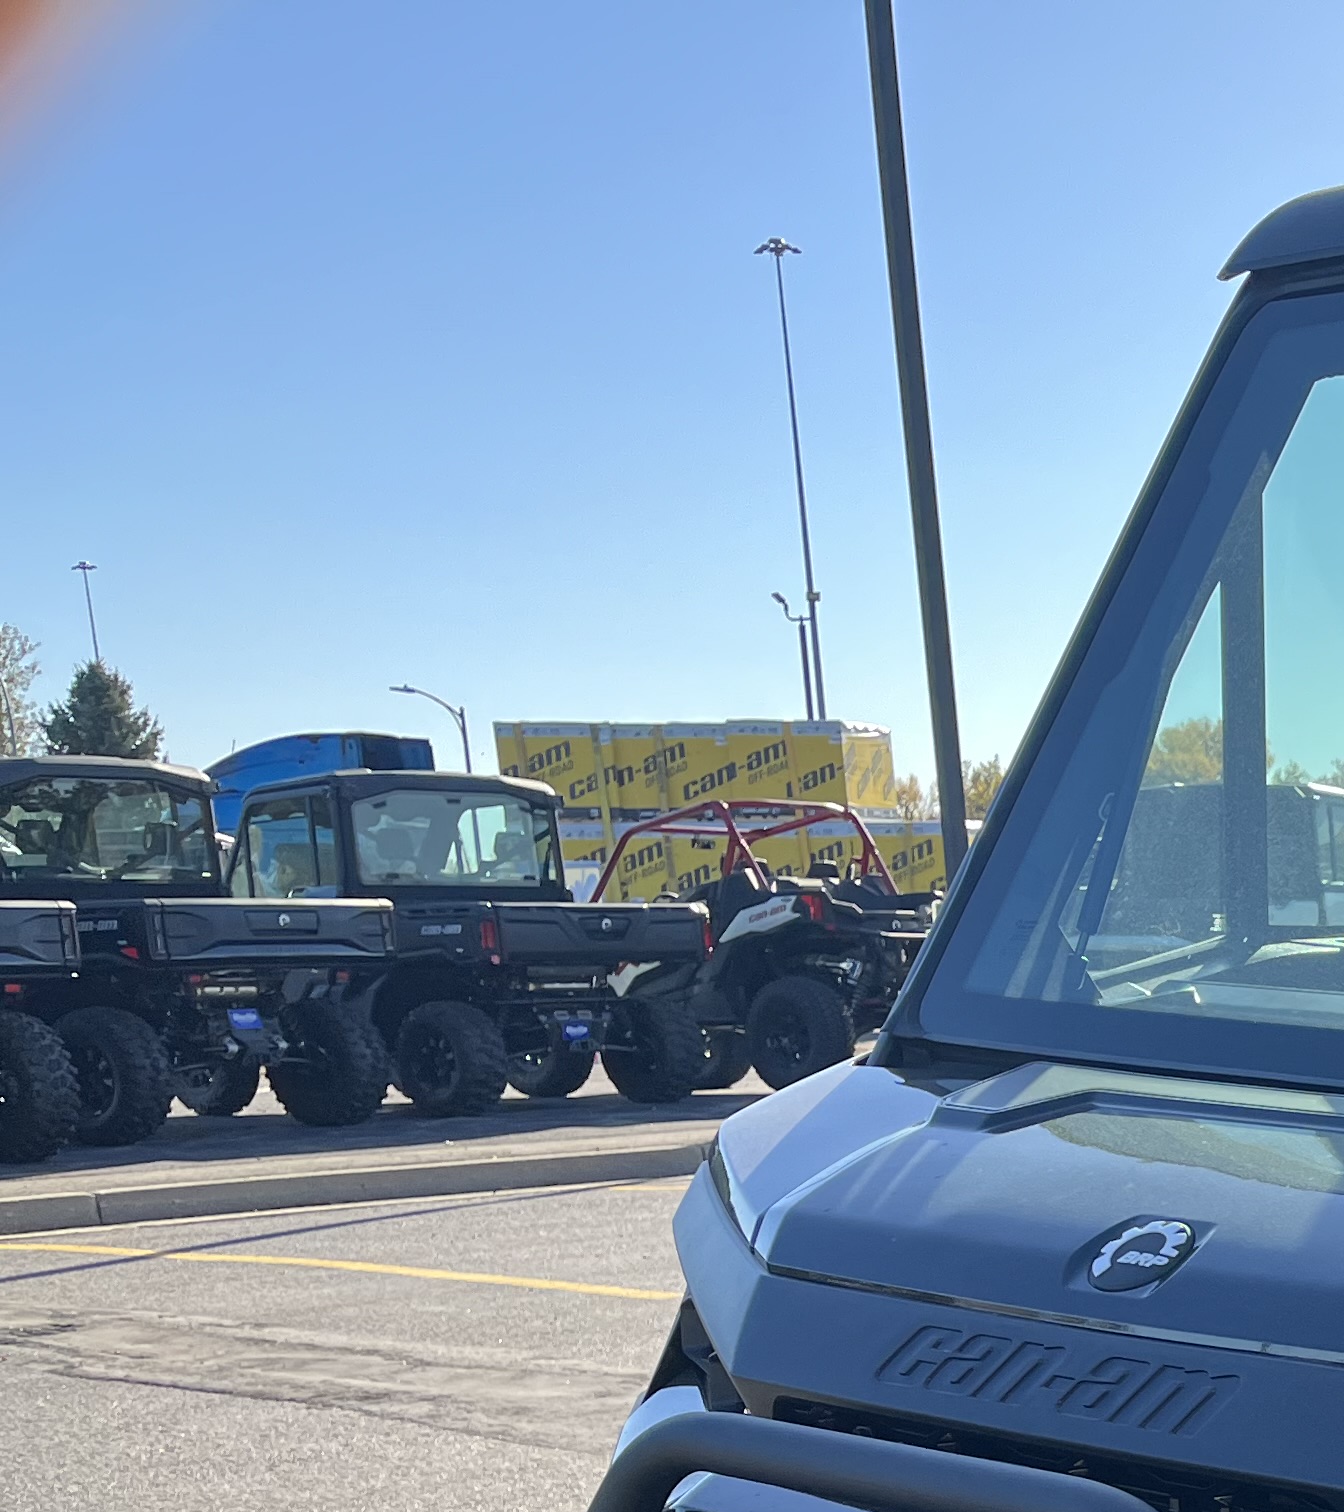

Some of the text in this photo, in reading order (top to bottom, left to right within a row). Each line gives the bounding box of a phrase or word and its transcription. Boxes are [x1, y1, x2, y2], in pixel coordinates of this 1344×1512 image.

[684, 740, 787, 801] can-am
[1116, 1250, 1170, 1269] BRP
[875, 1324, 1242, 1438] can-am
